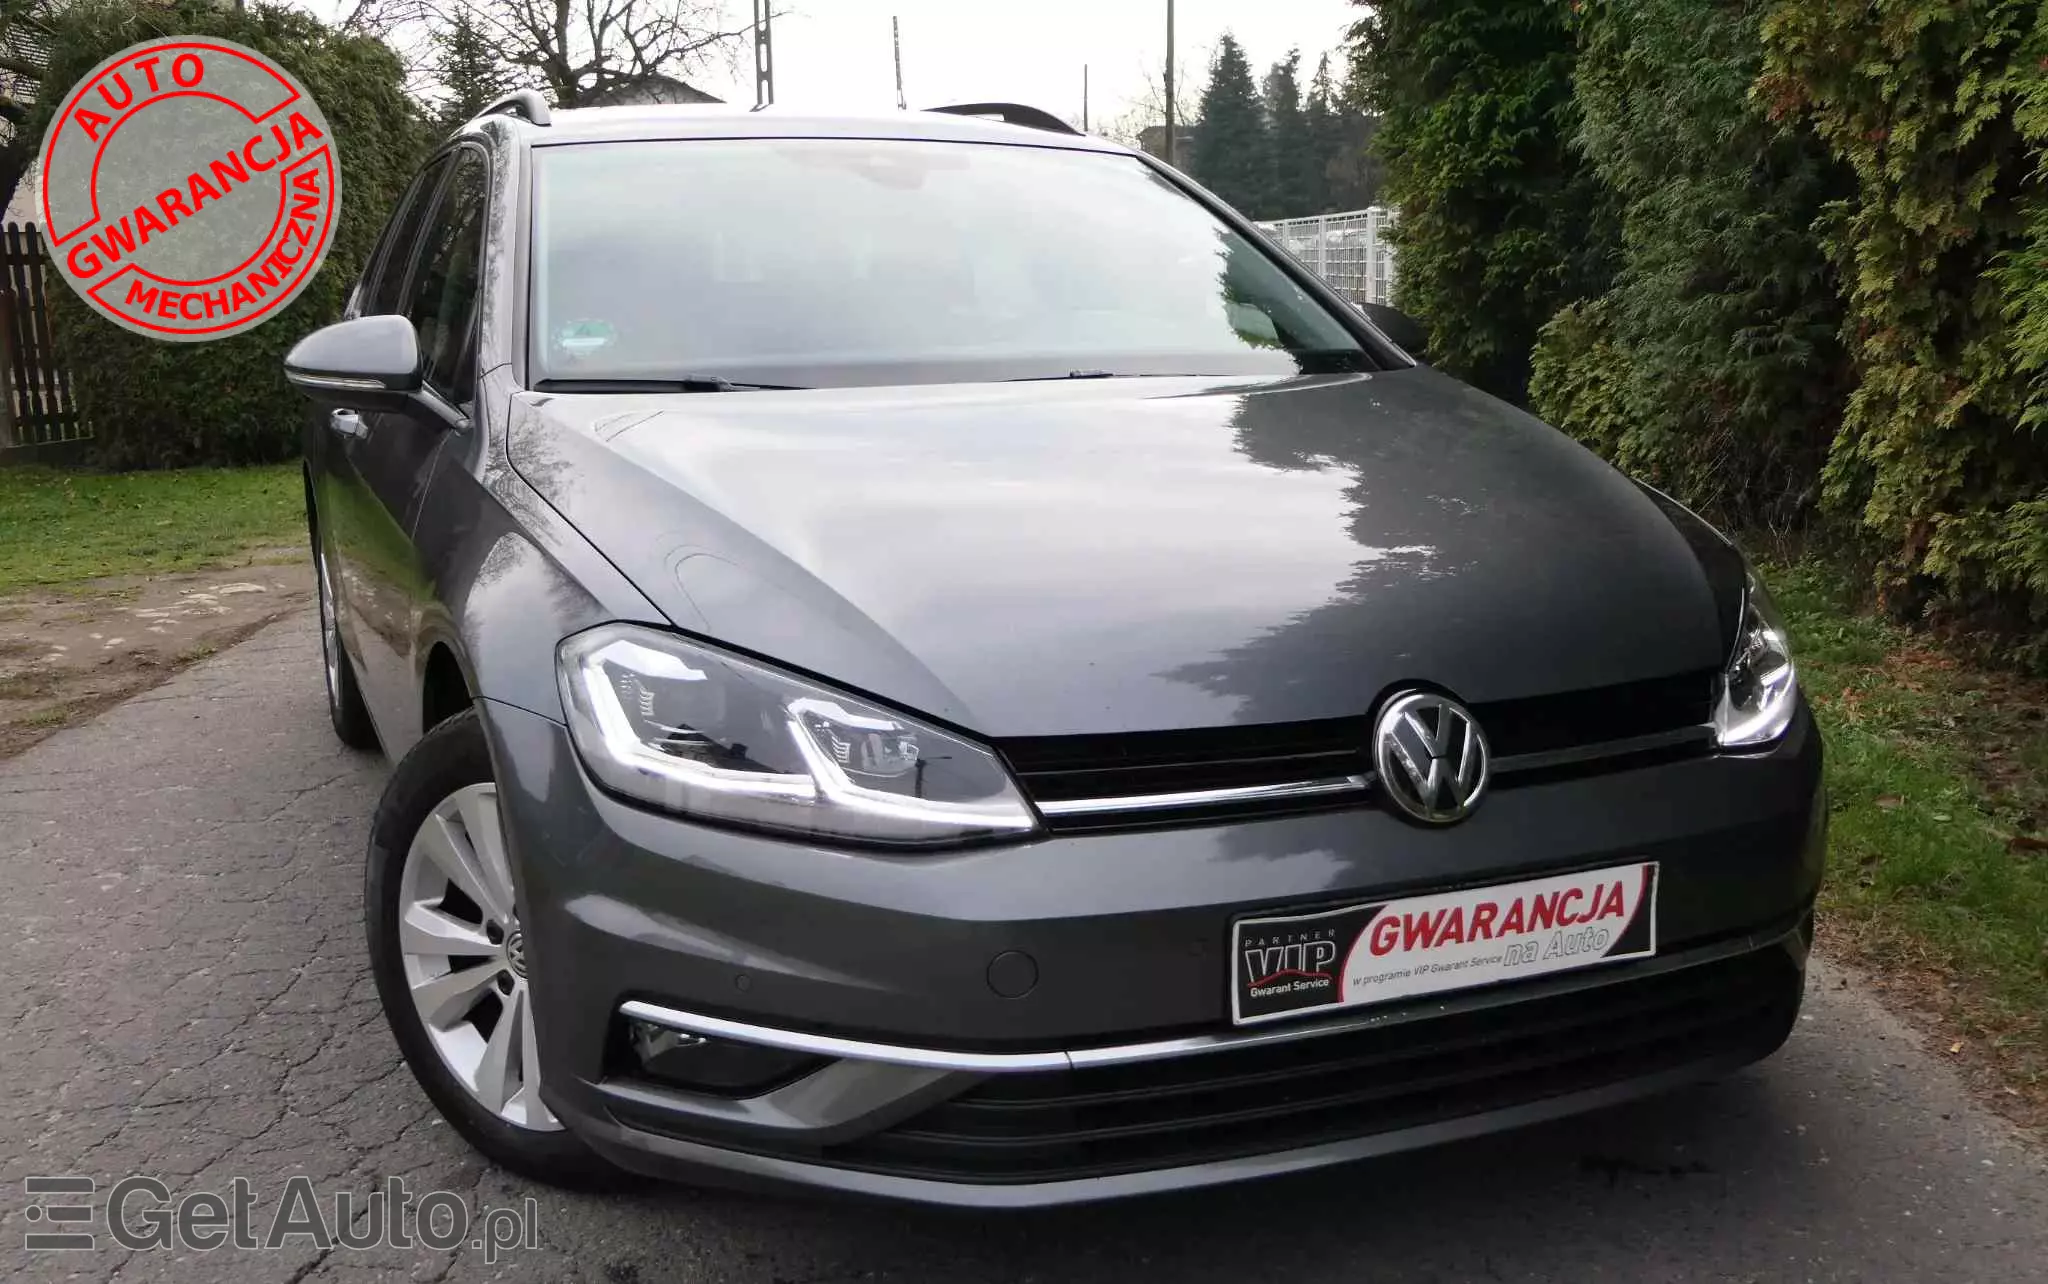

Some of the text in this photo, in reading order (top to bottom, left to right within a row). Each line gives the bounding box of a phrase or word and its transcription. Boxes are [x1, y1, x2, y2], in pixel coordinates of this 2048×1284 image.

[1370, 880, 1624, 956] GWARANCJA
[1244, 929, 1335, 947] PARTNER
[1504, 926, 1610, 966] na Auto
[1245, 941, 1336, 984] VIP
[1353, 954, 1503, 986] w programie VIP Gwarant Service
[1250, 979, 1330, 998] Gwarant Service
